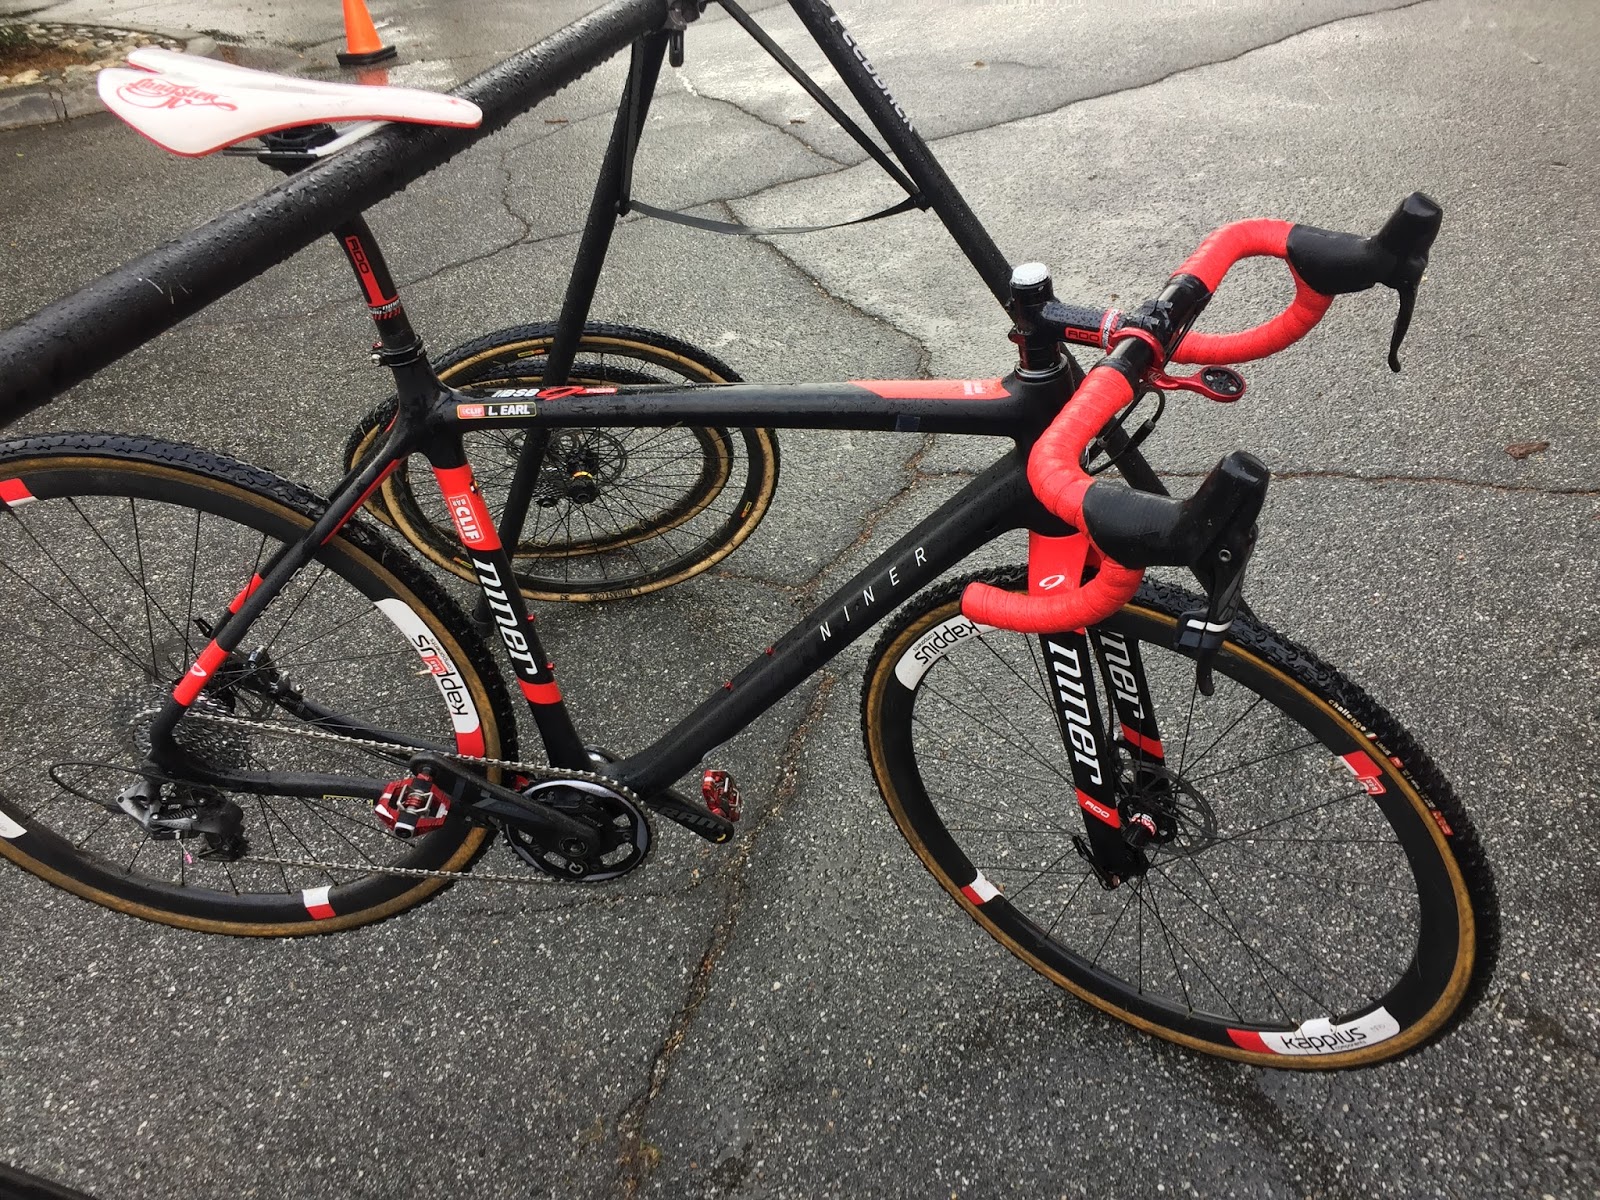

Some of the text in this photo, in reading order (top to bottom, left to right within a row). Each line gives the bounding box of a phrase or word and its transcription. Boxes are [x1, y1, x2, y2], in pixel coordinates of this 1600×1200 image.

[500, 405, 531, 416] EARL
[455, 506, 480, 540] CLIF
[473, 557, 539, 676] niner
[819, 546, 927, 642] NINER
[914, 619, 982, 665] kappius
[411, 634, 469, 716] kappus
[1048, 640, 1103, 786] niner
[1328, 699, 1367, 732] challenge
[1280, 1027, 1367, 1053] kappius
